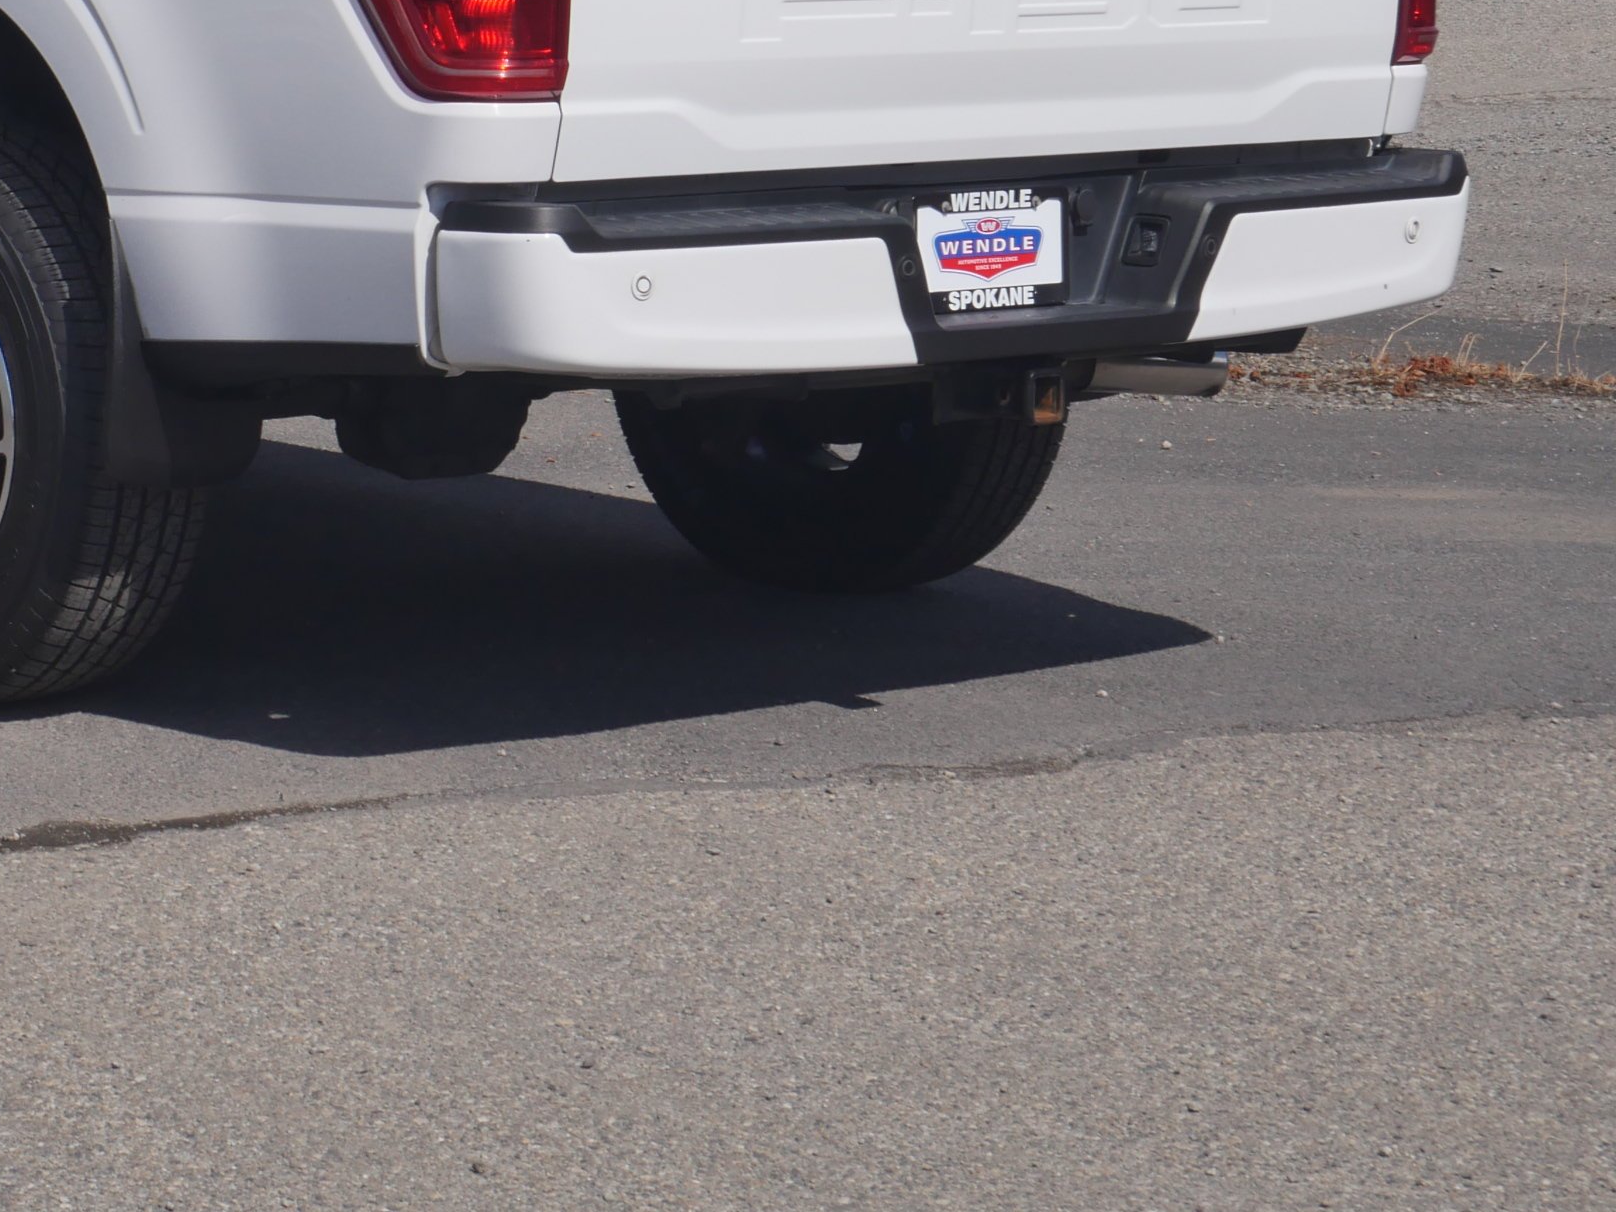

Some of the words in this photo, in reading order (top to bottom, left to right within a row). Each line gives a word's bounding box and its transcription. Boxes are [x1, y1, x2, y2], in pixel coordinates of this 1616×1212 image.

[951, 189, 1032, 212] WENDLE
[941, 236, 1034, 255] WENDLE
[948, 286, 1034, 311] SPOKANE
